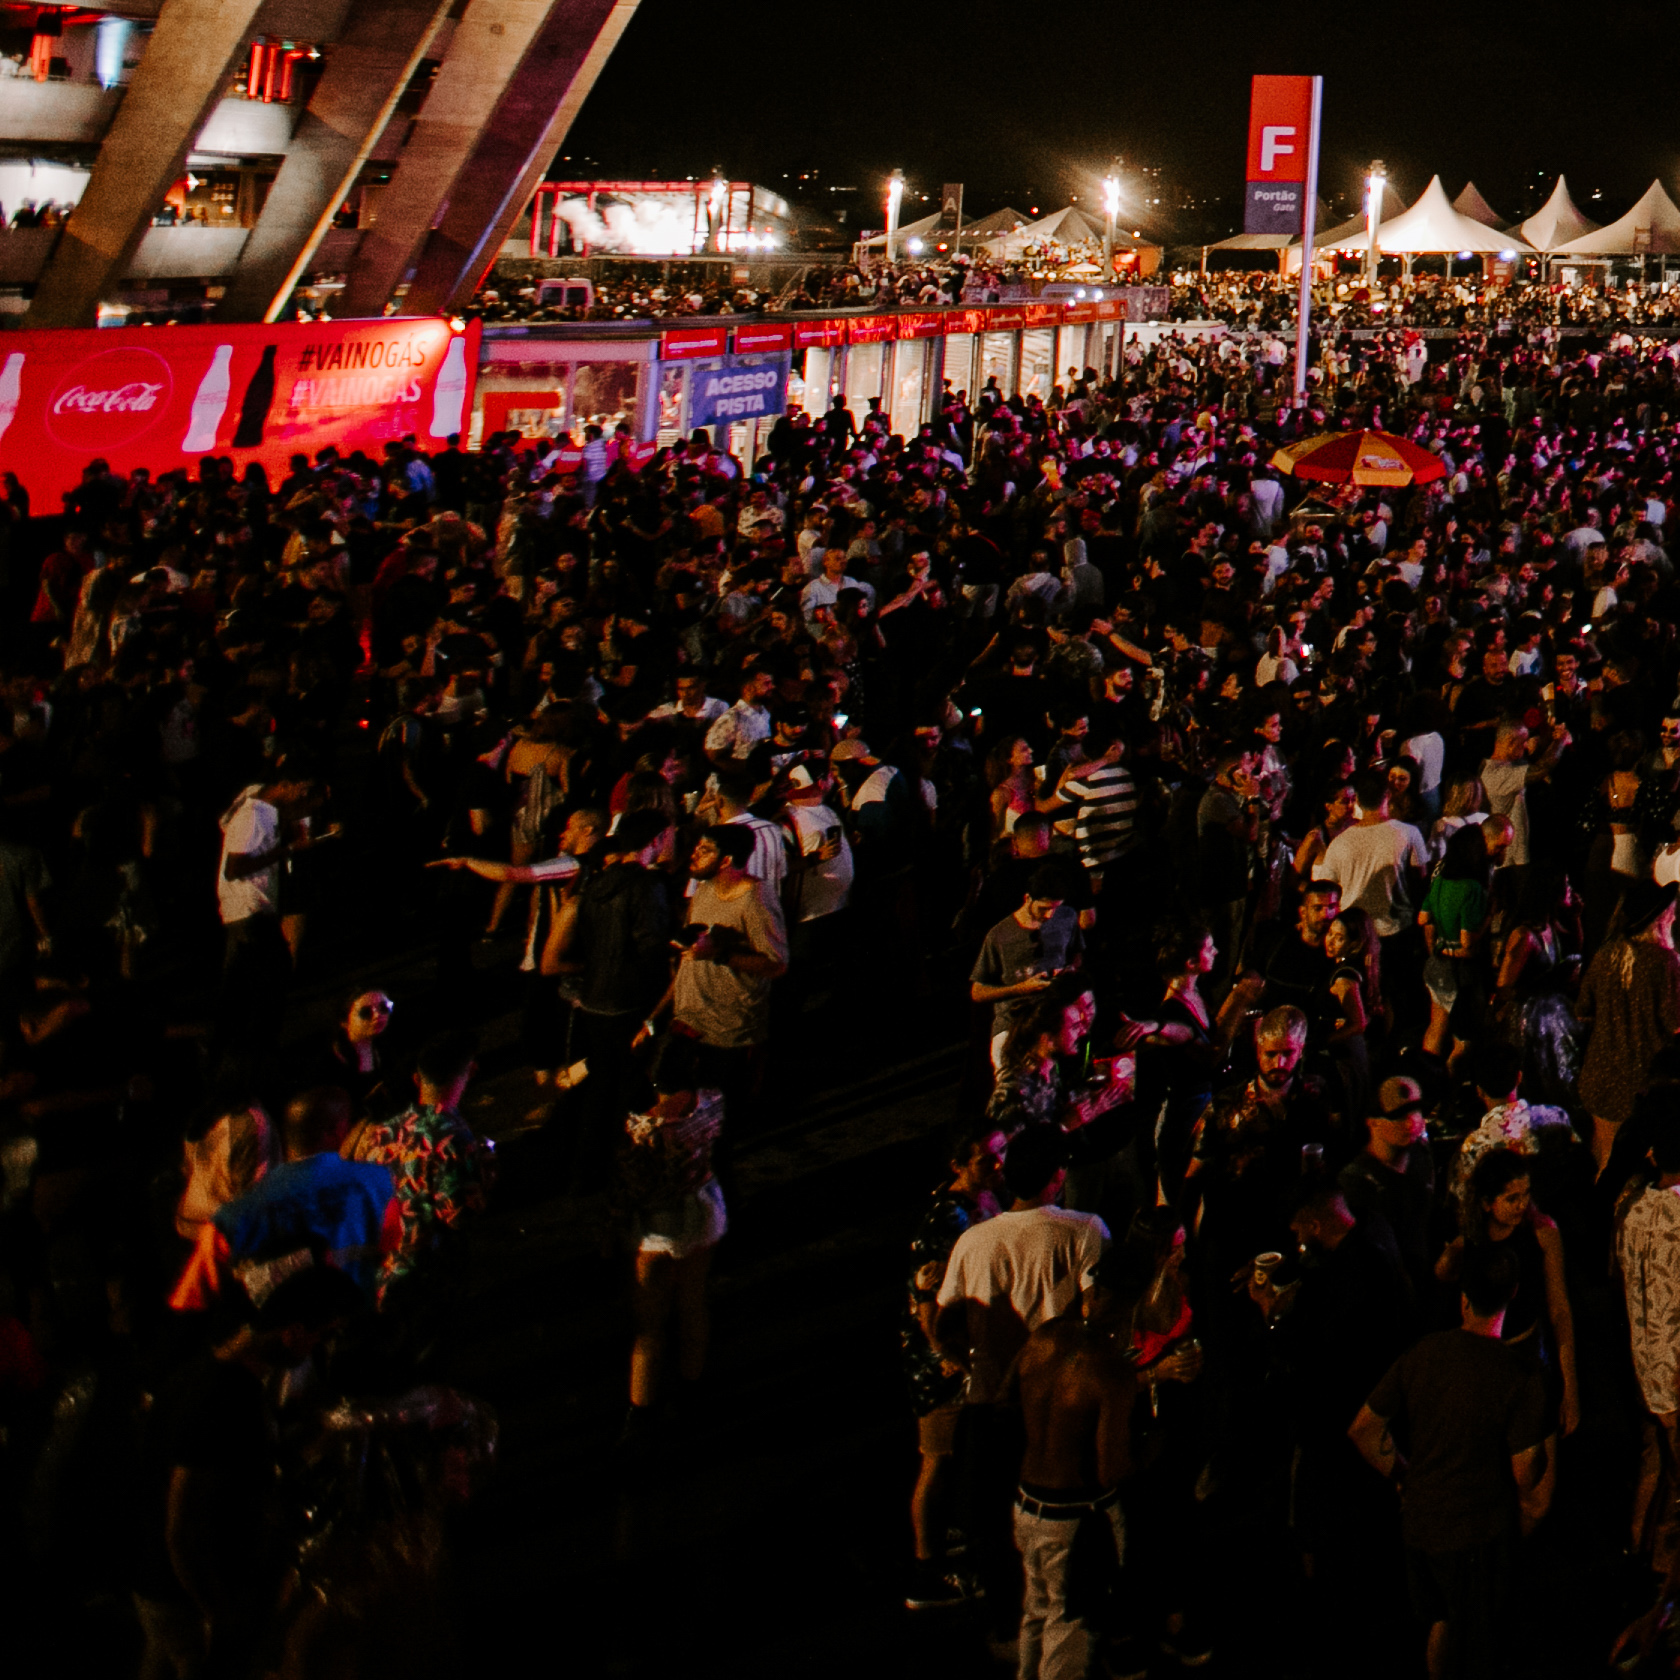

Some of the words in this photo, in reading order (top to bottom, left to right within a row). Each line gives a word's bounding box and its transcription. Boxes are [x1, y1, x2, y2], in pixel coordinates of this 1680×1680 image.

[1260, 126, 1296, 171] F
[944, 197, 957, 211] A
[1254, 190, 1297, 201] Portão
[1273, 203, 1296, 212] Gate
[298, 333, 427, 372] #VAINOGÁS
[705, 371, 777, 396] ACESSO
[53, 382, 165, 415] Coca-Cola
[716, 394, 765, 417] PISTA
